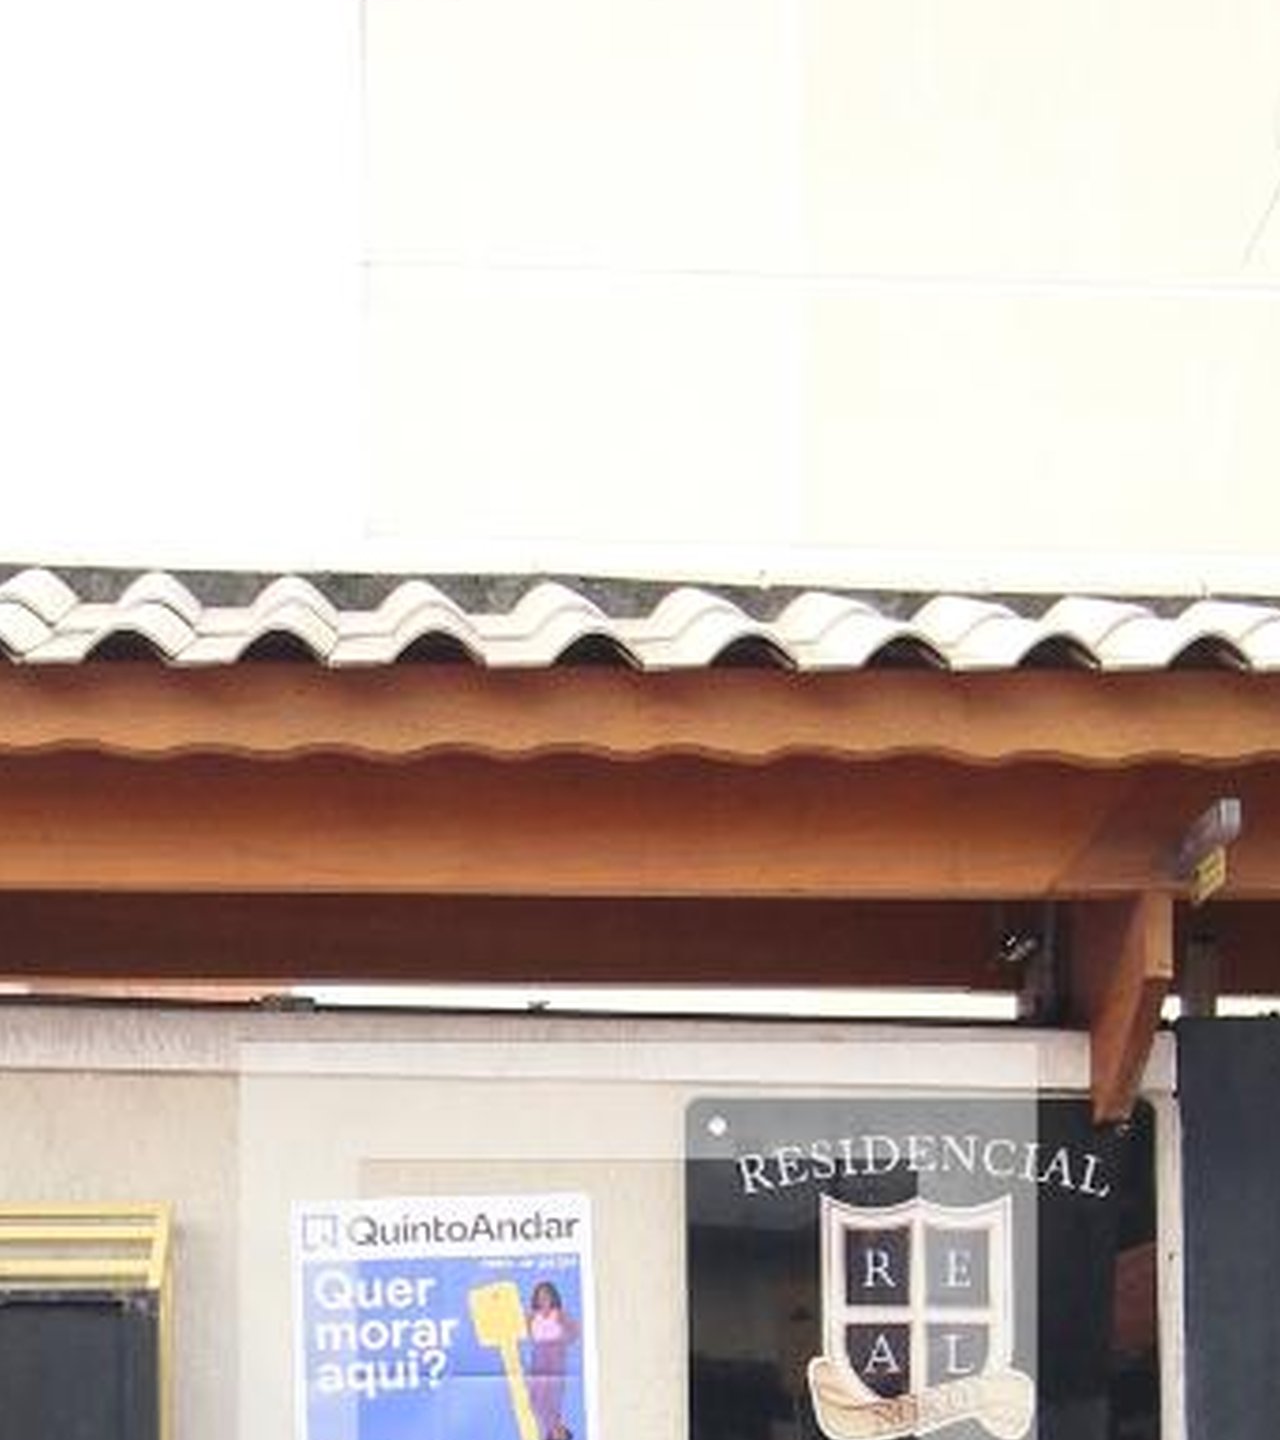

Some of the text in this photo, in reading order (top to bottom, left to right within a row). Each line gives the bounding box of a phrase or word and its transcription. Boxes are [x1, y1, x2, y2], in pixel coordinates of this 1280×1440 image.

[736, 1134, 1112, 1198] RESIDENCIAL
[347, 1211, 581, 1247] QuintoAndar
[863, 1248, 972, 1288] R E
[314, 1270, 436, 1311] Quer
[317, 1317, 459, 1350] morar
[318, 1350, 447, 1398] aqui?
[863, 1334, 975, 1374] A L
